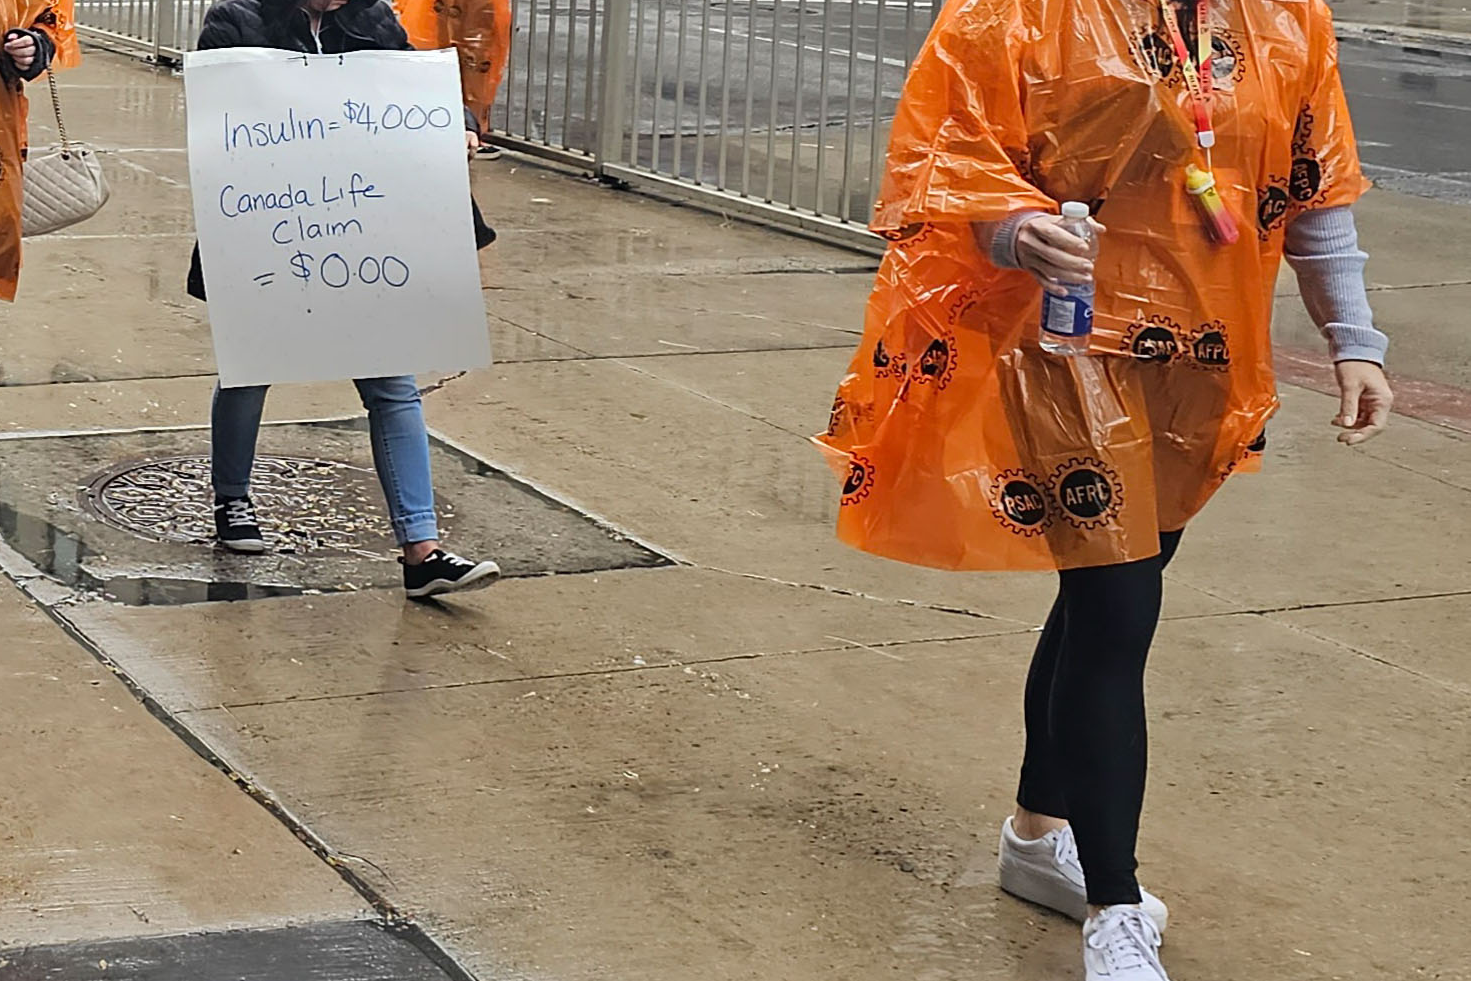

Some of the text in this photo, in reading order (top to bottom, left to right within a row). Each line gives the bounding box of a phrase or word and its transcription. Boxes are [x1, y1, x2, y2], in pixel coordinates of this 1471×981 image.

[220, 173, 386, 218] Canada Life
[272, 216, 363, 245] Claim
[1066, 481, 1110, 505] AFPC
